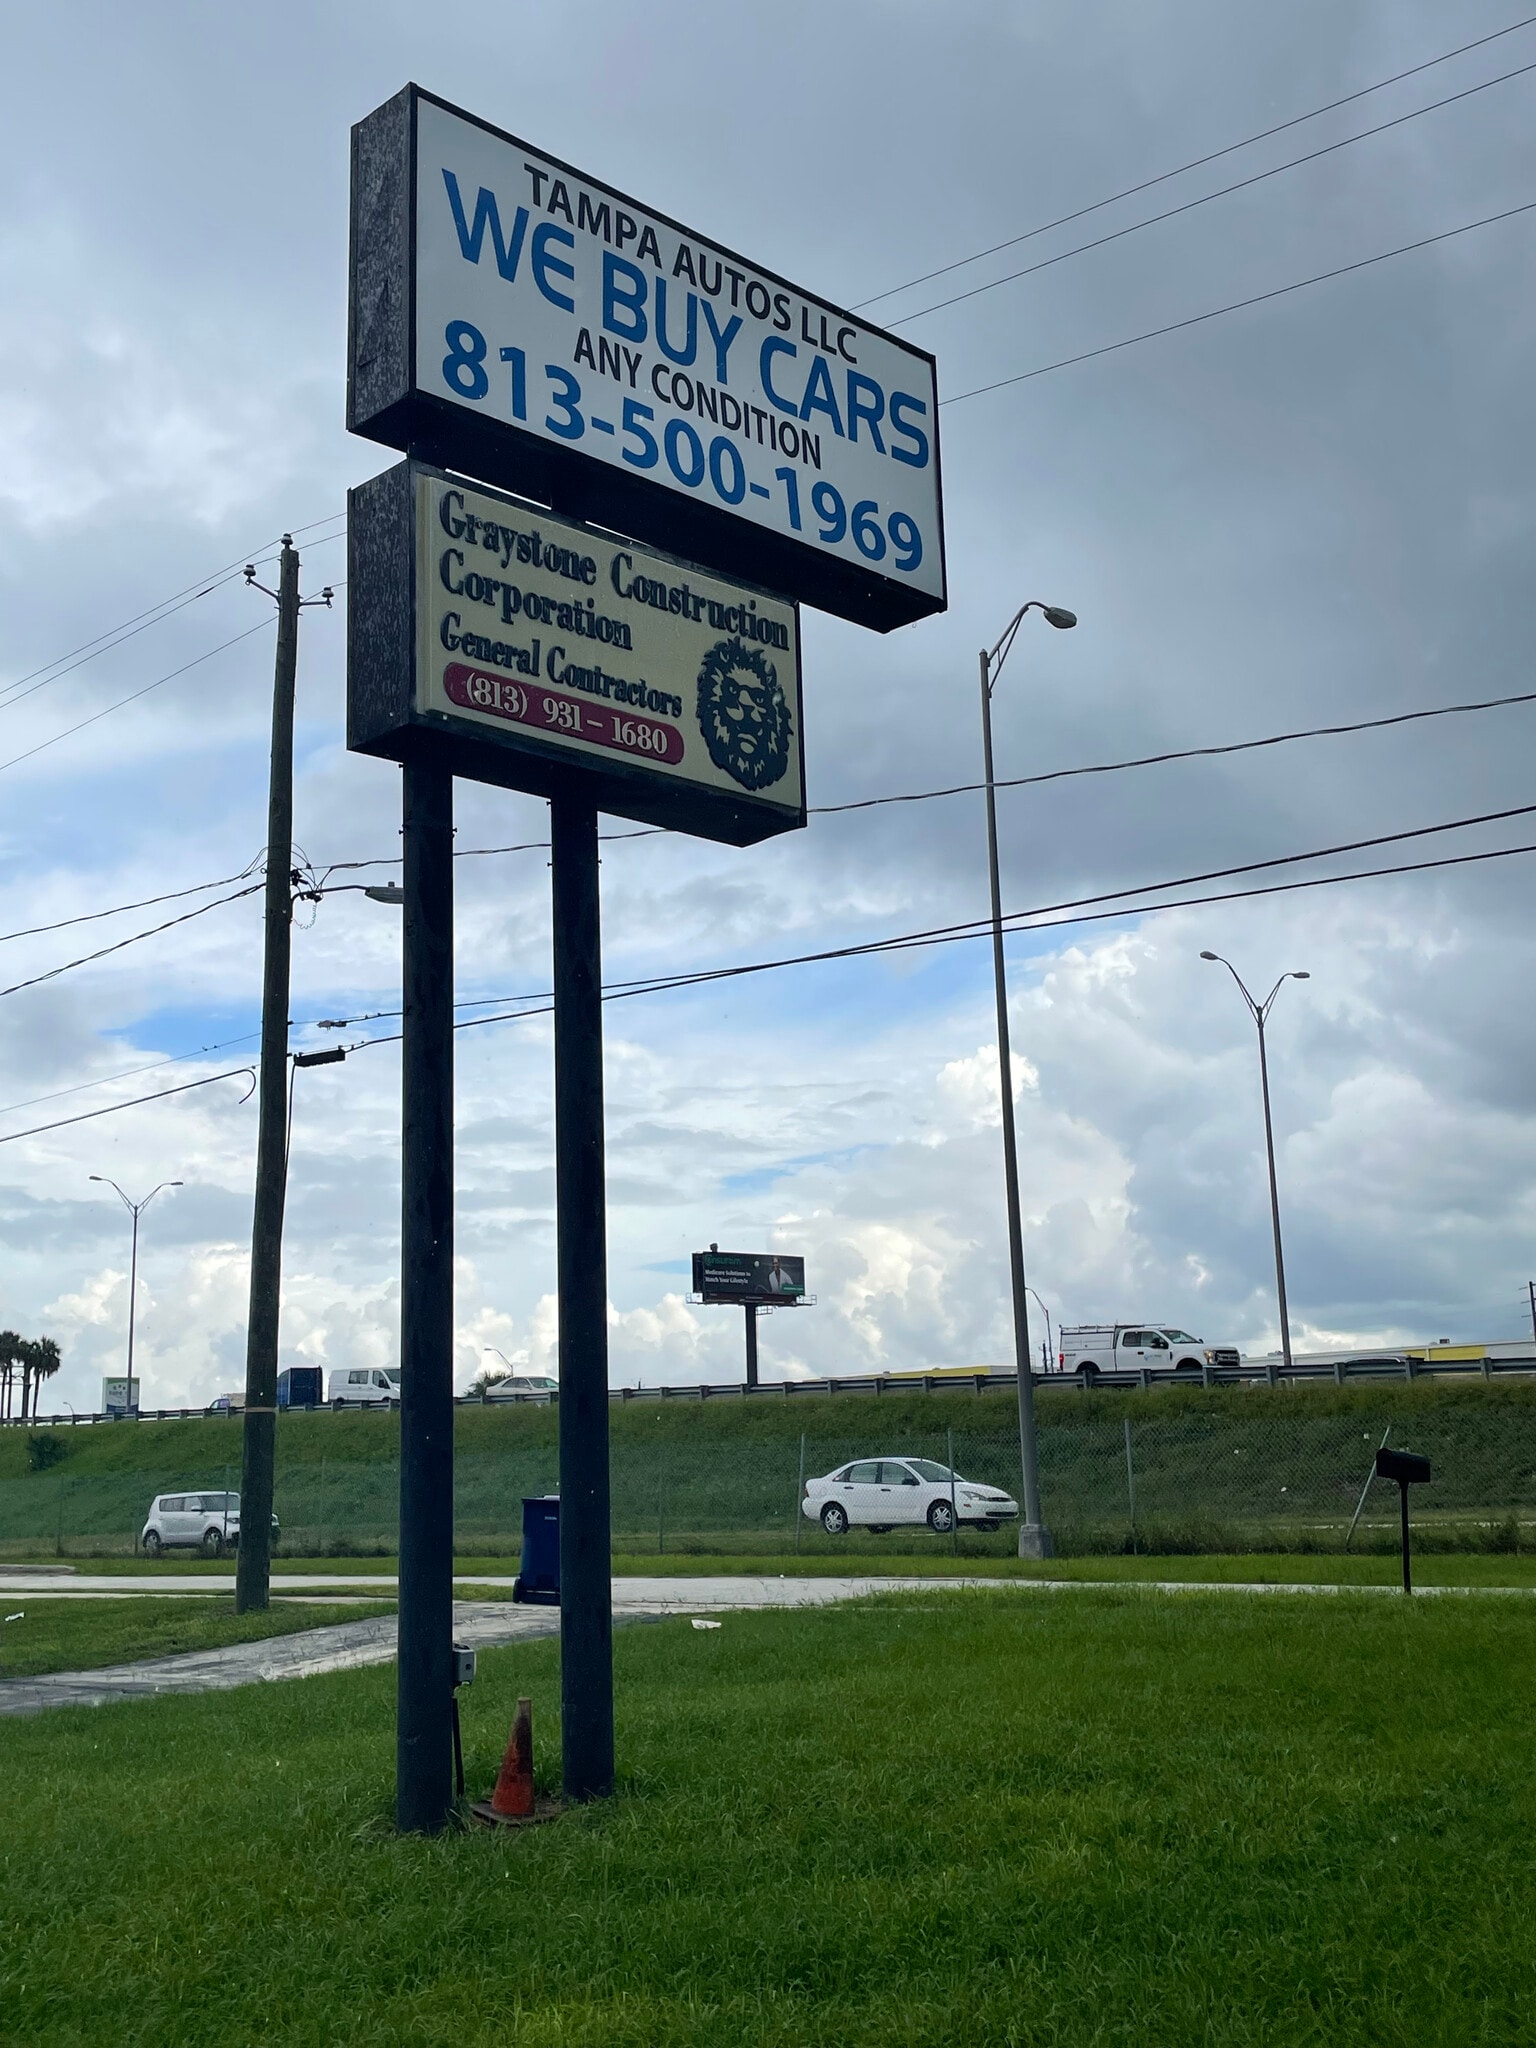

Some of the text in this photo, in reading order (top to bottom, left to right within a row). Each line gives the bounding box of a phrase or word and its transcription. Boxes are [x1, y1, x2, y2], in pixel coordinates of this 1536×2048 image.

[441, 168, 929, 468] WE BUY CARS
[524, 163, 857, 364] TAMPA AUTOS LLC
[442, 319, 923, 572] 813-500-1969
[573, 327, 821, 470] ANY CONDITION
[439, 490, 790, 651] Graystone Construction
[440, 548, 633, 650] Corporation
[440, 611, 682, 718] General Contractors
[465, 672, 528, 719] (813)
